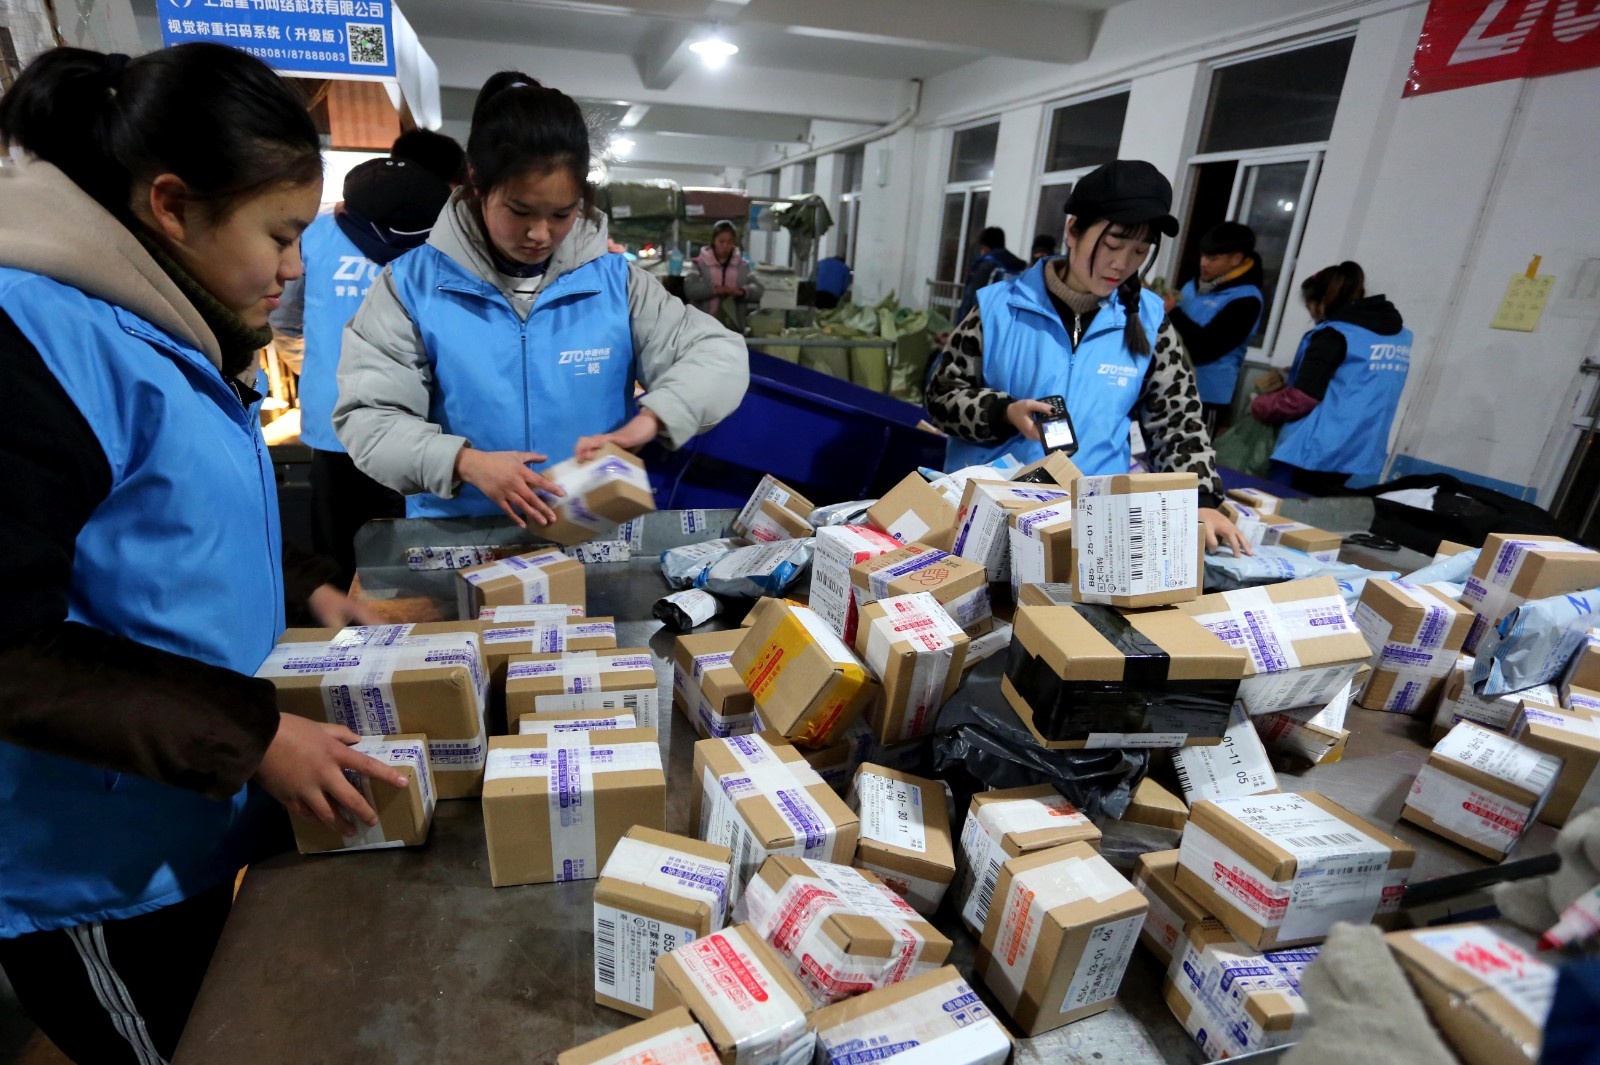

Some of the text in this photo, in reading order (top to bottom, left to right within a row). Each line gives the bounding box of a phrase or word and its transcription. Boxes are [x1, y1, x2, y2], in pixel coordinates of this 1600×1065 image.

[558, 350, 584, 364] ZTO
[1369, 344, 1396, 360] ZTO
[1097, 364, 1118, 374] ZTO
[1086, 504, 1092, 516] 75
[1235, 770, 1250, 786] 05
[897, 810, 908, 821] 30
[898, 823, 908, 834] 11
[1087, 948, 1106, 976] 03-01
[1101, 928, 1113, 944] 66
